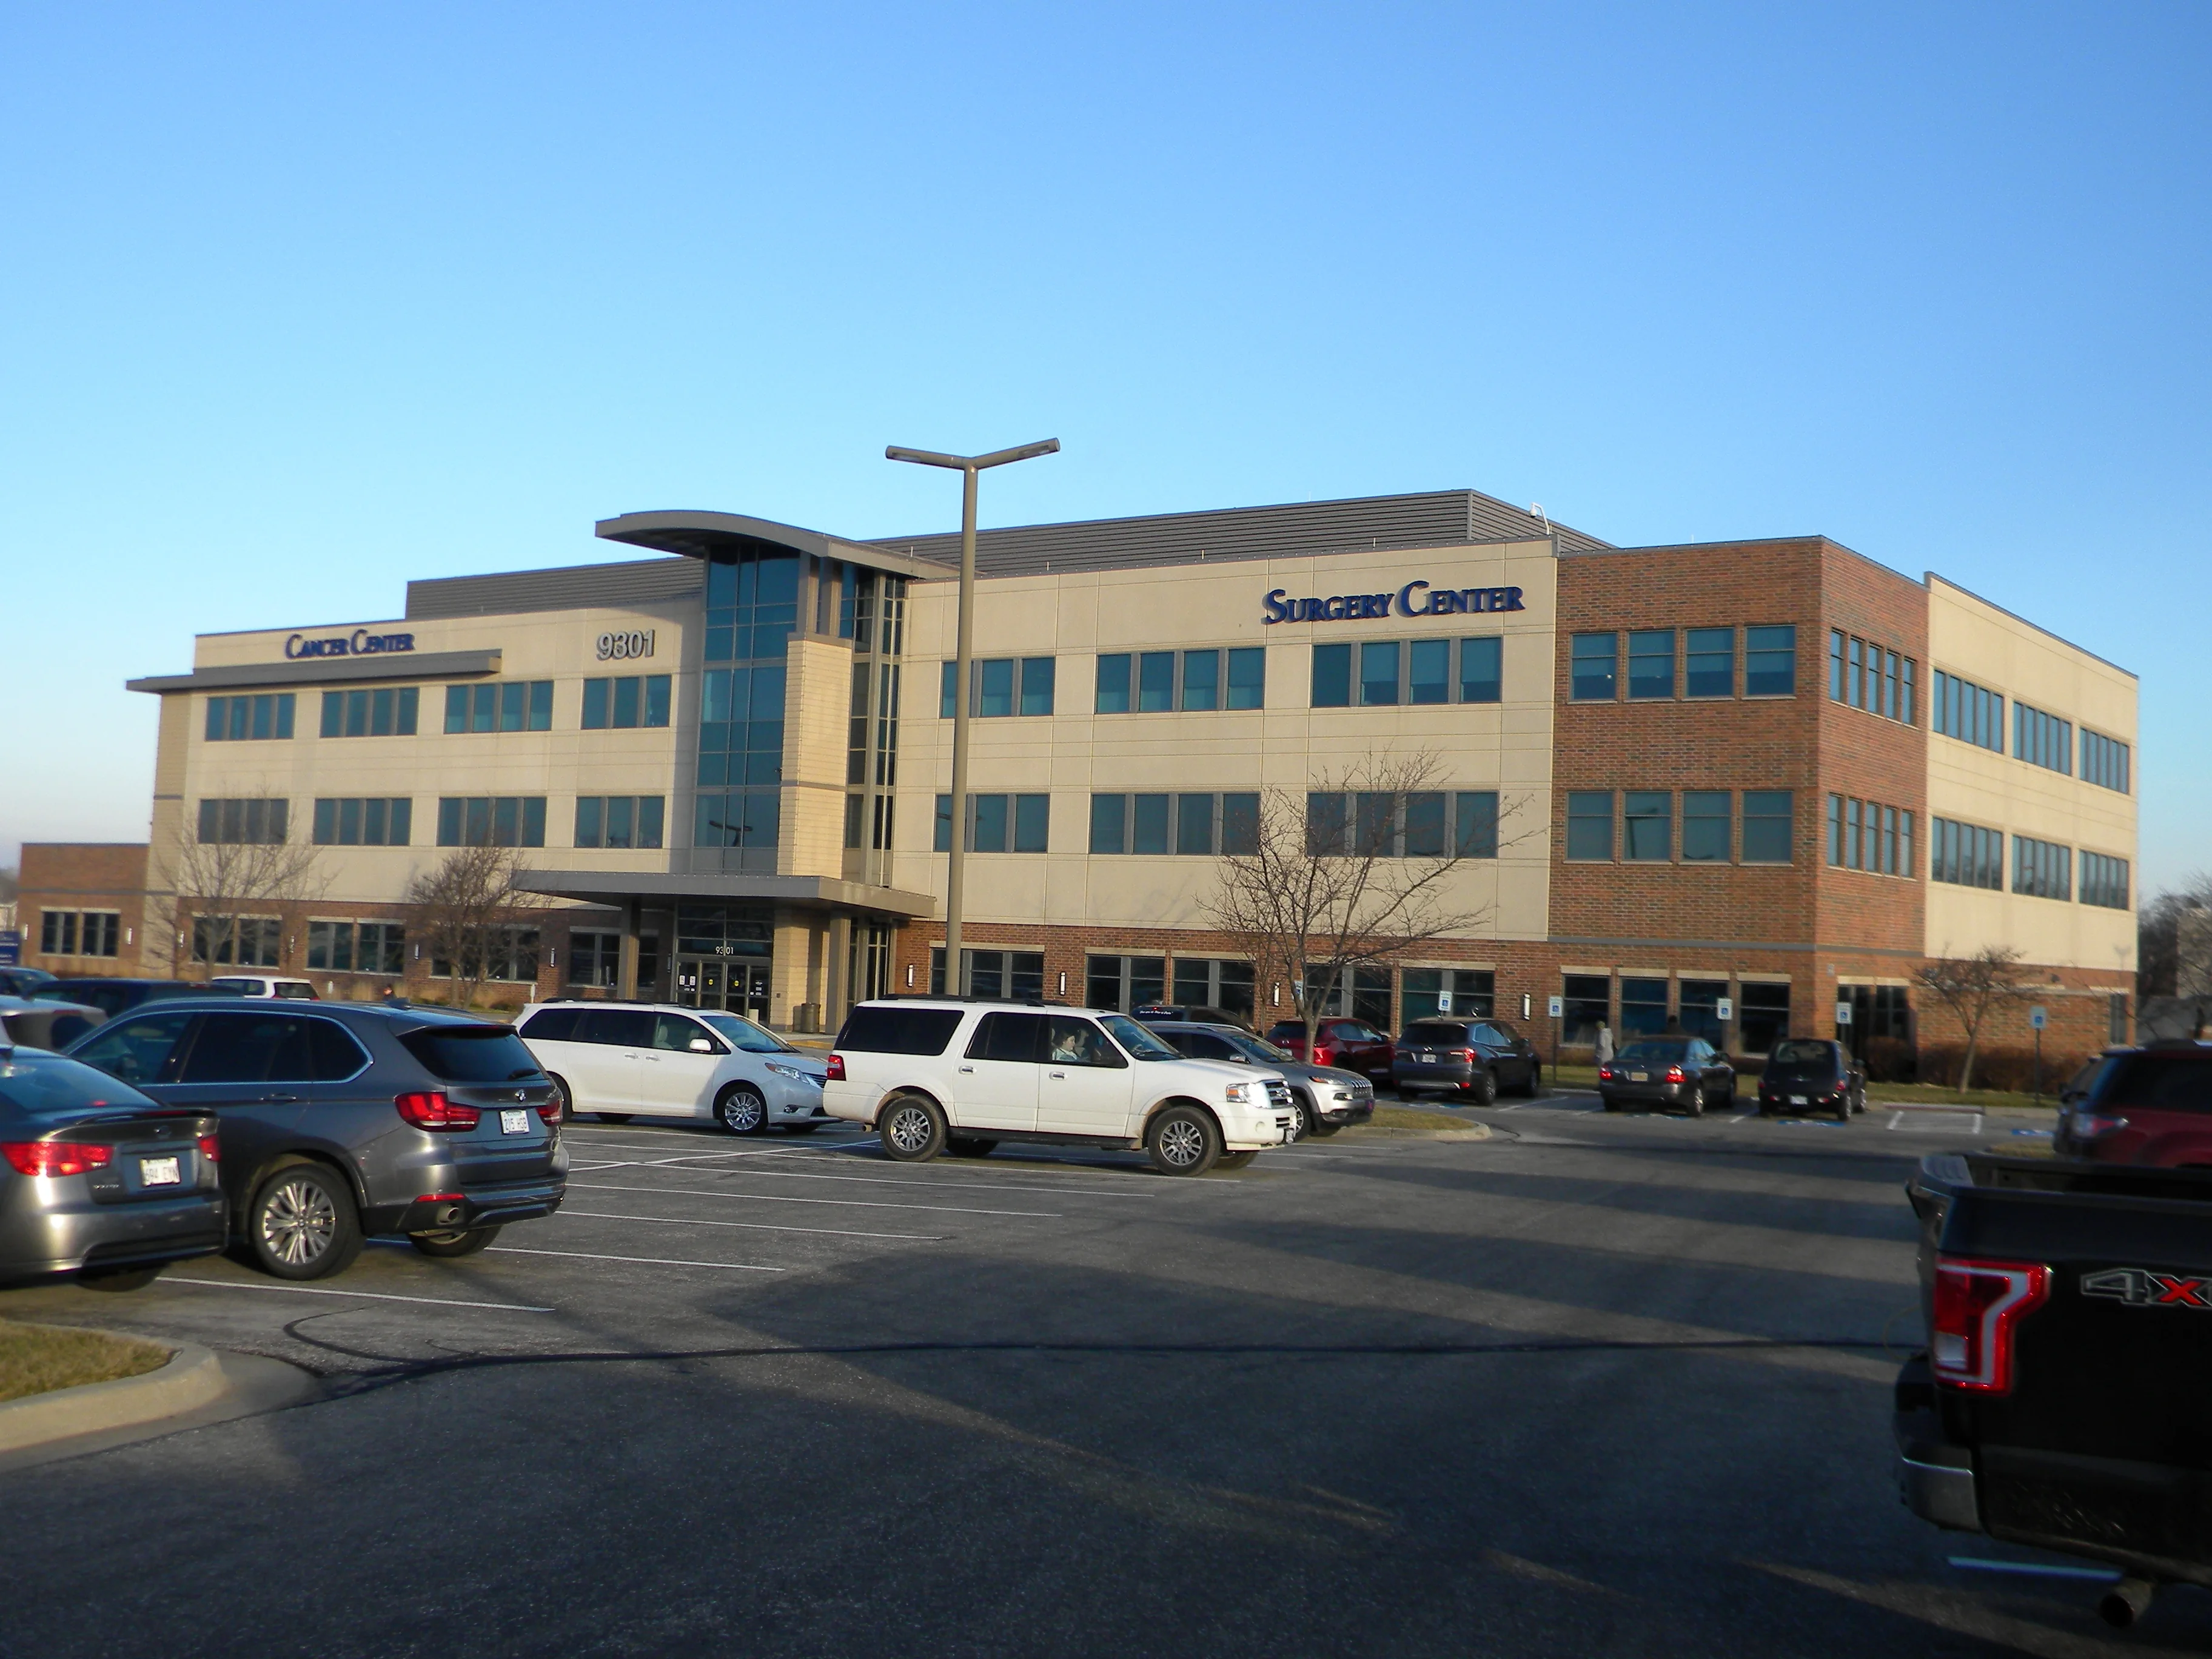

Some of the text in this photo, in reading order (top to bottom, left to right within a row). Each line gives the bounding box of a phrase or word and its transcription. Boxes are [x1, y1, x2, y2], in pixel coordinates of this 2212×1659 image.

[1261, 580, 1526, 625] SURGERY CENTER
[286, 629, 415, 659] CANCER CENTER
[597, 629, 655, 661] 9301
[716, 946, 734, 954] 9301
[504, 1119, 515, 1130] 215
[2081, 1268, 2212, 1308] 4X
